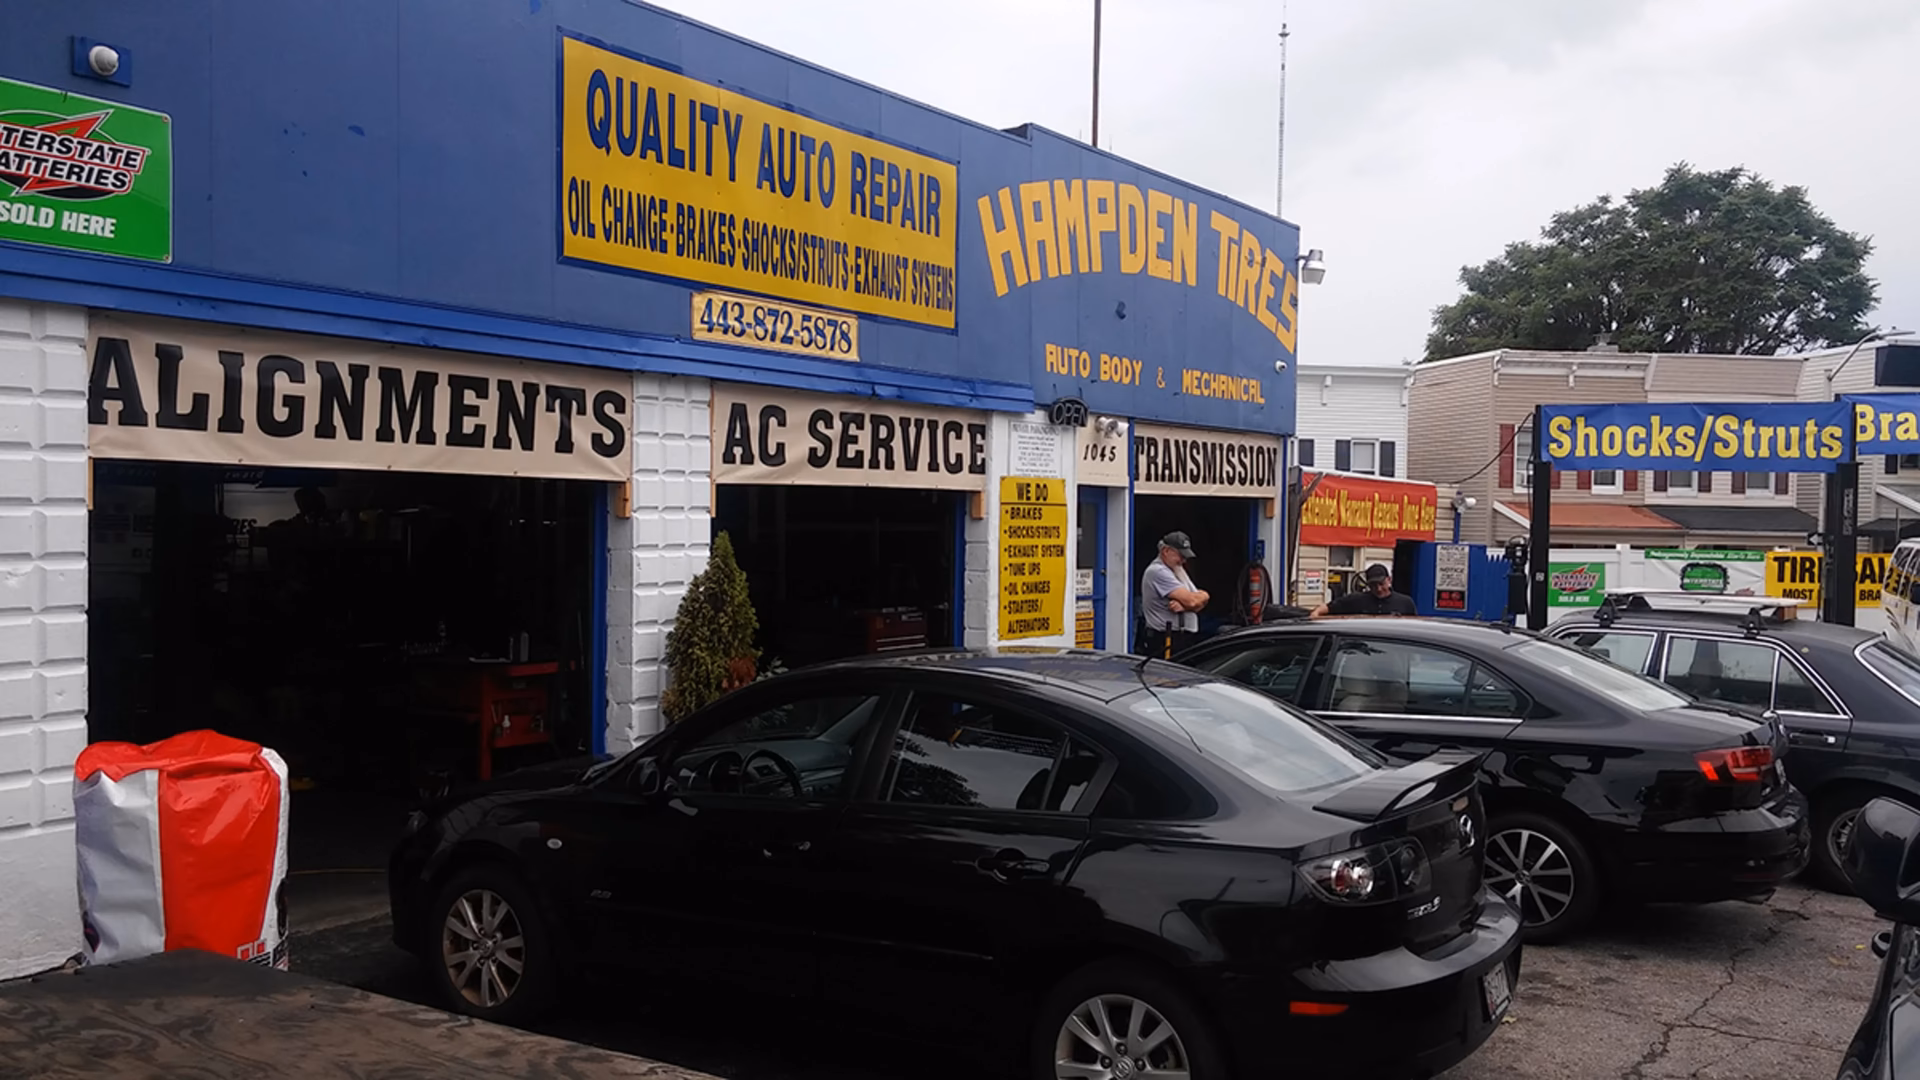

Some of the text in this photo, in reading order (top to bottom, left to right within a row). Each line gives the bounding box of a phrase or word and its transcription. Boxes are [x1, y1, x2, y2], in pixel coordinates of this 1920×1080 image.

[0, 126, 141, 169] TERSTATE
[587, 69, 941, 238] QUALITY AUTO REPAIR
[0, 151, 130, 190] ATTERIES
[0, 201, 117, 238] SOLD HERE
[978, 179, 1198, 297] HAMPDEN
[568, 176, 954, 312] OIL CHANGE BRAKES SHOCKS/STRUTS EXHAUST SYSTEMS
[700, 300, 852, 354] 443-872-5878
[1045, 343, 1266, 405] AUTO BODY & MECHANICAL
[88, 336, 627, 459] ALIGNMENTS
[1053, 402, 1088, 426] OPEN
[722, 402, 788, 468] AC
[807, 408, 986, 475] SERVICE
[1549, 414, 1843, 463] Shocks/Struts
[1856, 402, 1920, 443] Bra
[1083, 443, 1117, 463] 1045
[1133, 435, 1278, 488] TRANSMISSION
[1016, 483, 1049, 501] WE DO
[1008, 526, 1060, 539] SHOCKS/STRUTS
[1010, 507, 1043, 521] BRAKES
[1008, 545, 1065, 558] EXHAUST SYSTEM
[1008, 562, 1041, 576] TUNE UPS
[1773, 556, 1822, 584] TIR
[1008, 581, 1050, 595] OIL CHANGES
[1782, 588, 1814, 600] MOST
[1859, 590, 1882, 601] BRA
